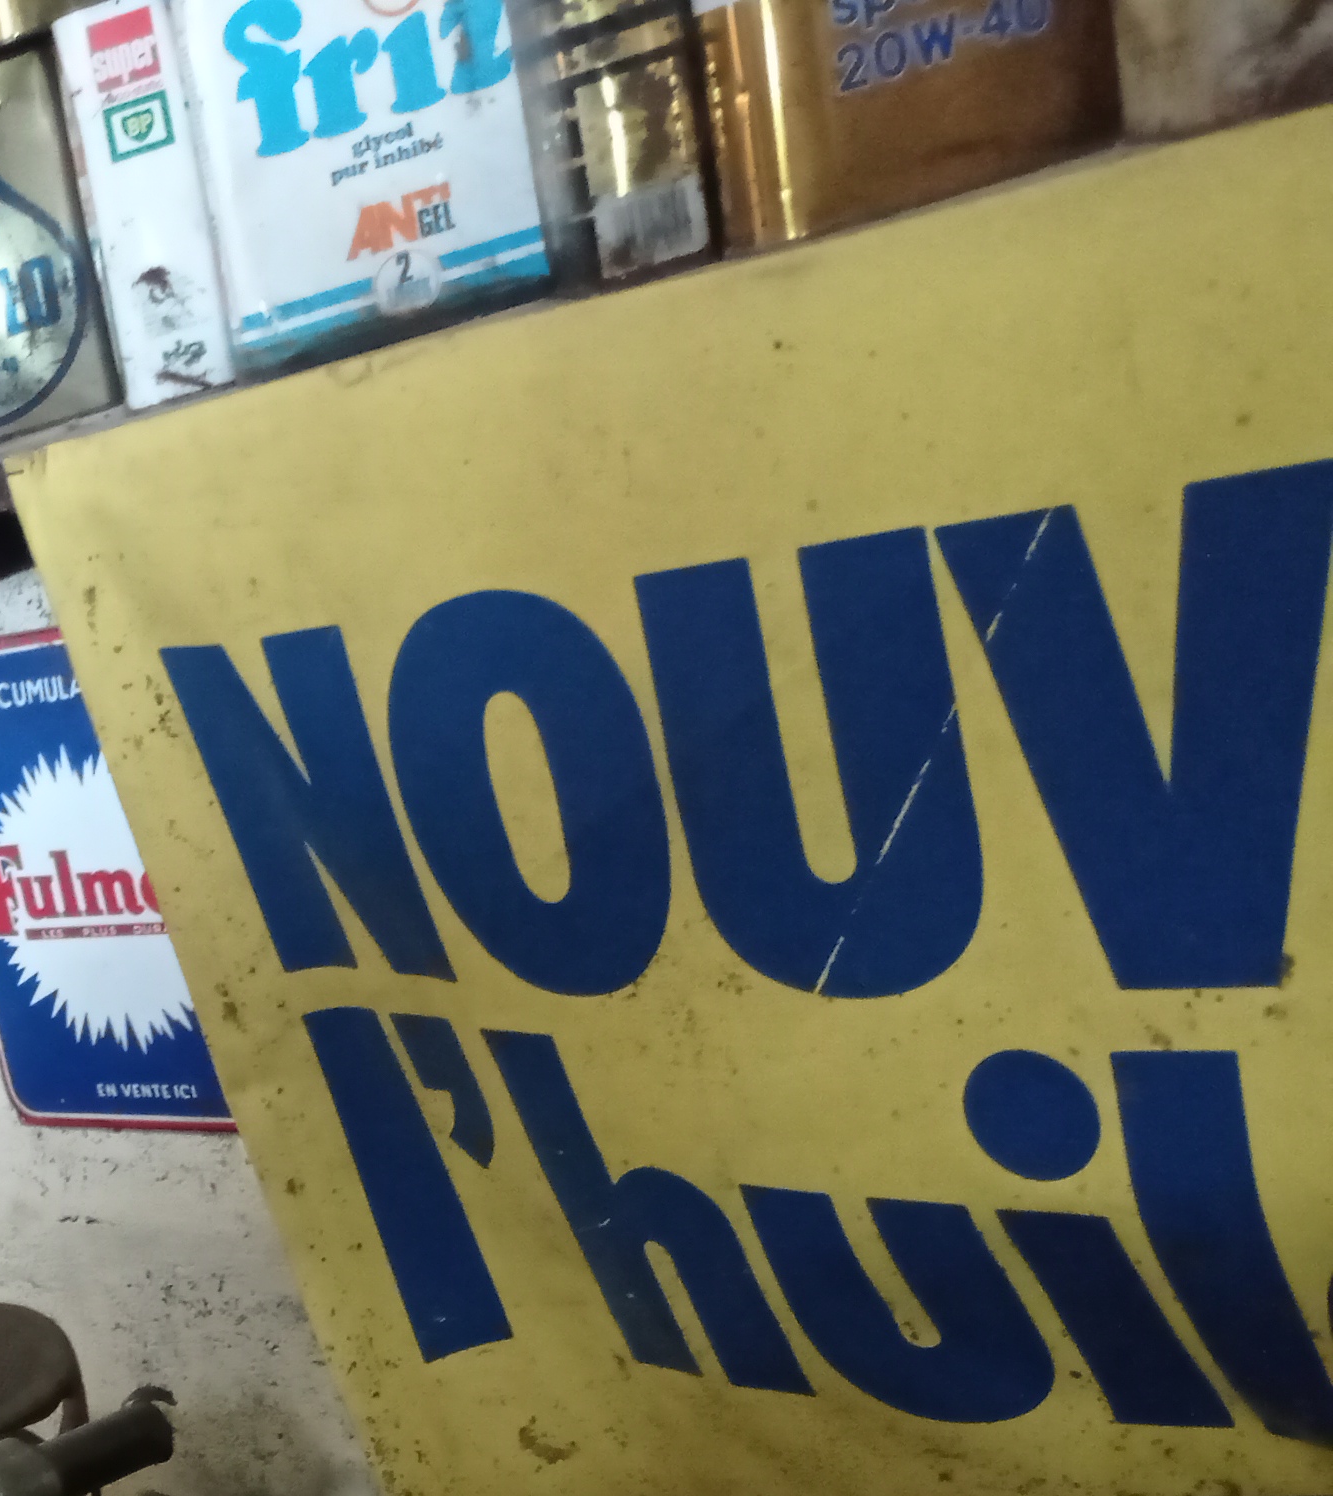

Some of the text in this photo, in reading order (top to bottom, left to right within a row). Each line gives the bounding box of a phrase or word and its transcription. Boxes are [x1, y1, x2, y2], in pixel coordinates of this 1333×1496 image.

[331, 160, 369, 187] pur
[417, 201, 456, 239] GEL
[158, 456, 1333, 1000] NOUV
[82, 926, 118, 937] PLUS
[96, 1083, 199, 1100] EN VENTE ICI
[302, 1007, 1333, 1445] l'huil
